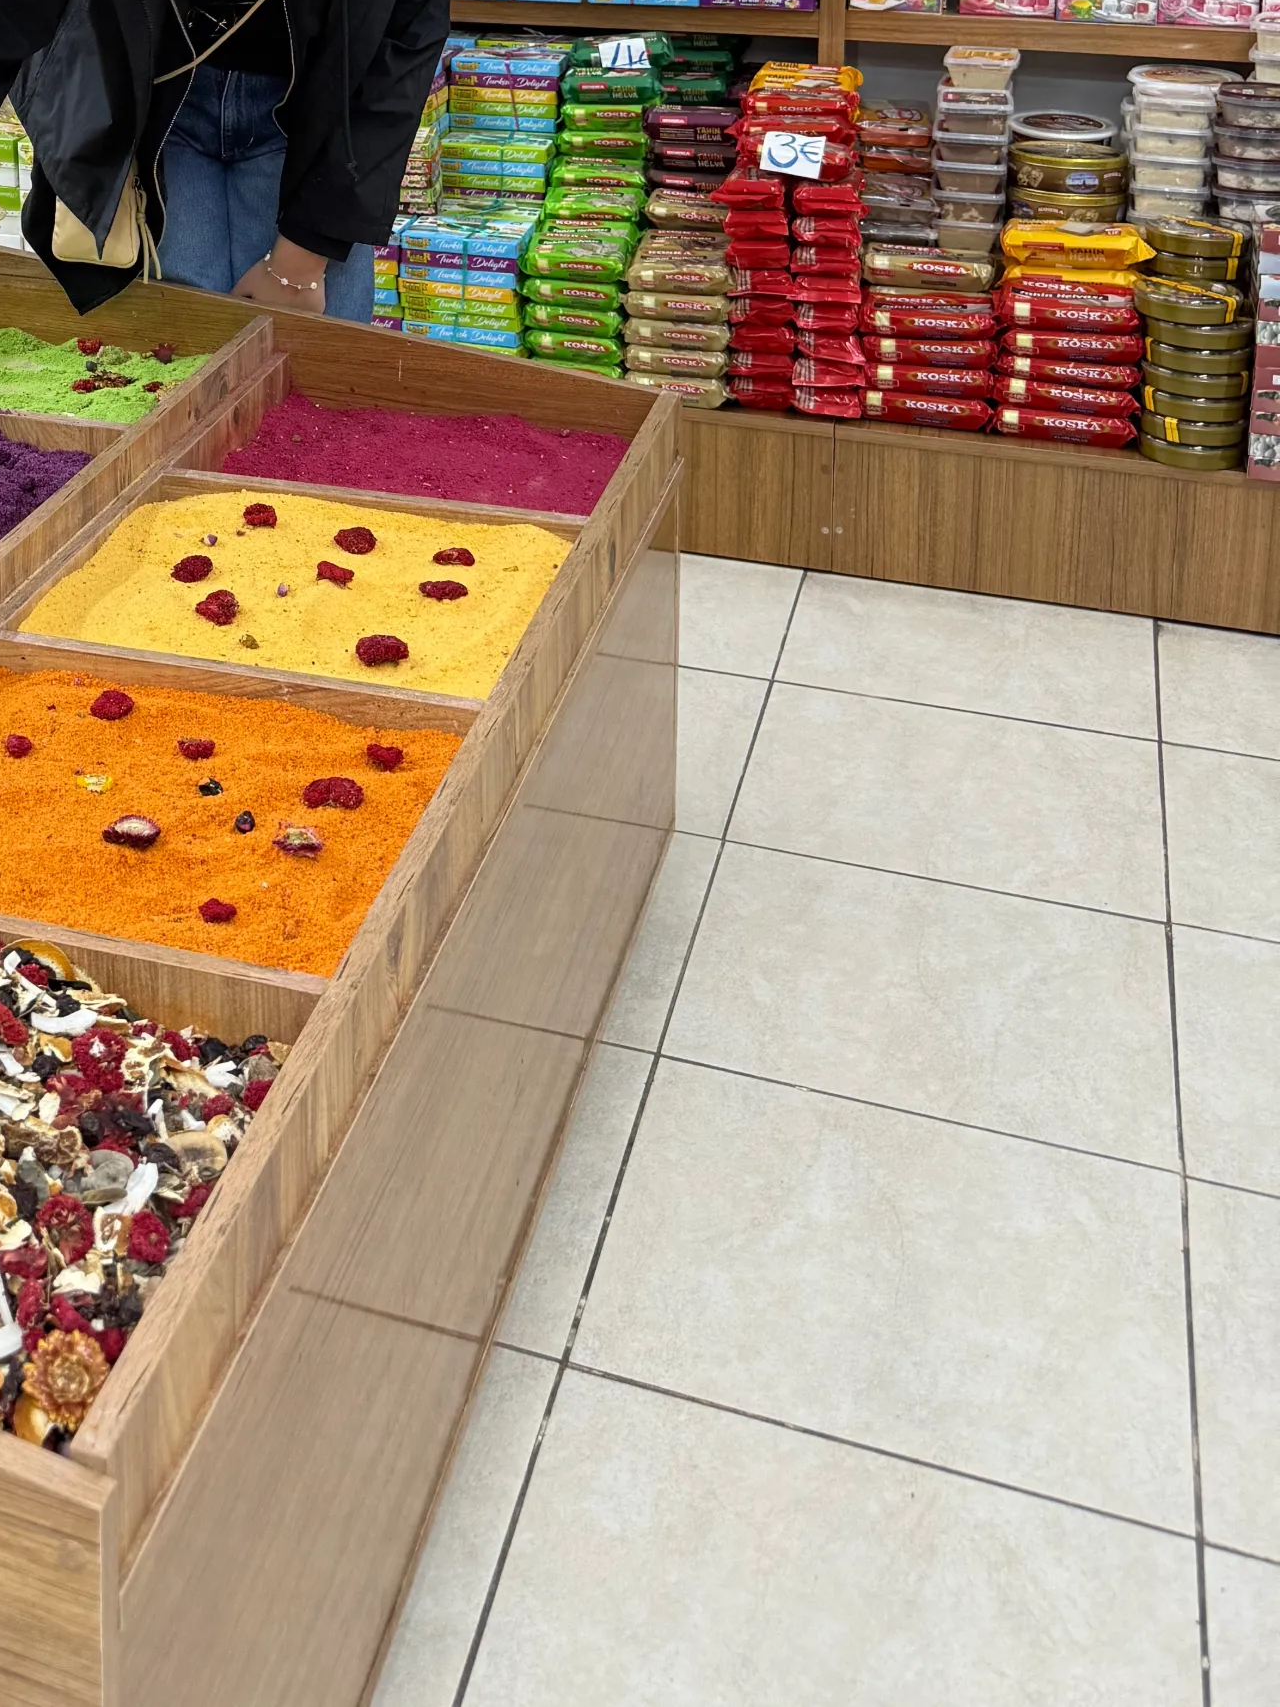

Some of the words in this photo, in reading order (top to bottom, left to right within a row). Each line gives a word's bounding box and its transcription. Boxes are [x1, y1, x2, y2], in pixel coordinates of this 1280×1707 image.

[515, 78, 551, 90] Delight
[503, 149, 538, 160] Delight
[768, 134, 823, 169] 3€
[586, 177, 628, 187] KOSKA
[662, 189, 705, 199] KOSKA
[471, 242, 508, 254] Delight
[471, 257, 509, 269] Delight
[559, 262, 603, 270] KOSKA
[912, 262, 967, 275] KOSKA
[665, 273, 710, 282] KOSKA
[1022, 280, 1086, 293] KOSKA
[563, 289, 606, 299] KOSKA
[471, 301, 506, 314] Delight
[667, 301, 712, 311] KOSKA
[558, 315, 601, 326] KOSKA
[1055, 309, 1113, 322] KOSKA
[914, 318, 970, 329] KOSKA
[471, 330, 507, 343] Delight
[663, 332, 707, 341] KOSKA
[563, 341, 606, 352] KOSKA
[1058, 337, 1115, 350] KOSKA
[920, 344, 976, 355] KOSKA
[662, 357, 706, 367] KOSKA
[917, 372, 972, 383] KOSKA
[1055, 366, 1113, 380] KOSKA
[661, 384, 706, 394] KOSKA
[1050, 389, 1109, 404] KOSKA
[905, 399, 962, 414] KOSKA
[1043, 417, 1101, 432] KOSKA
